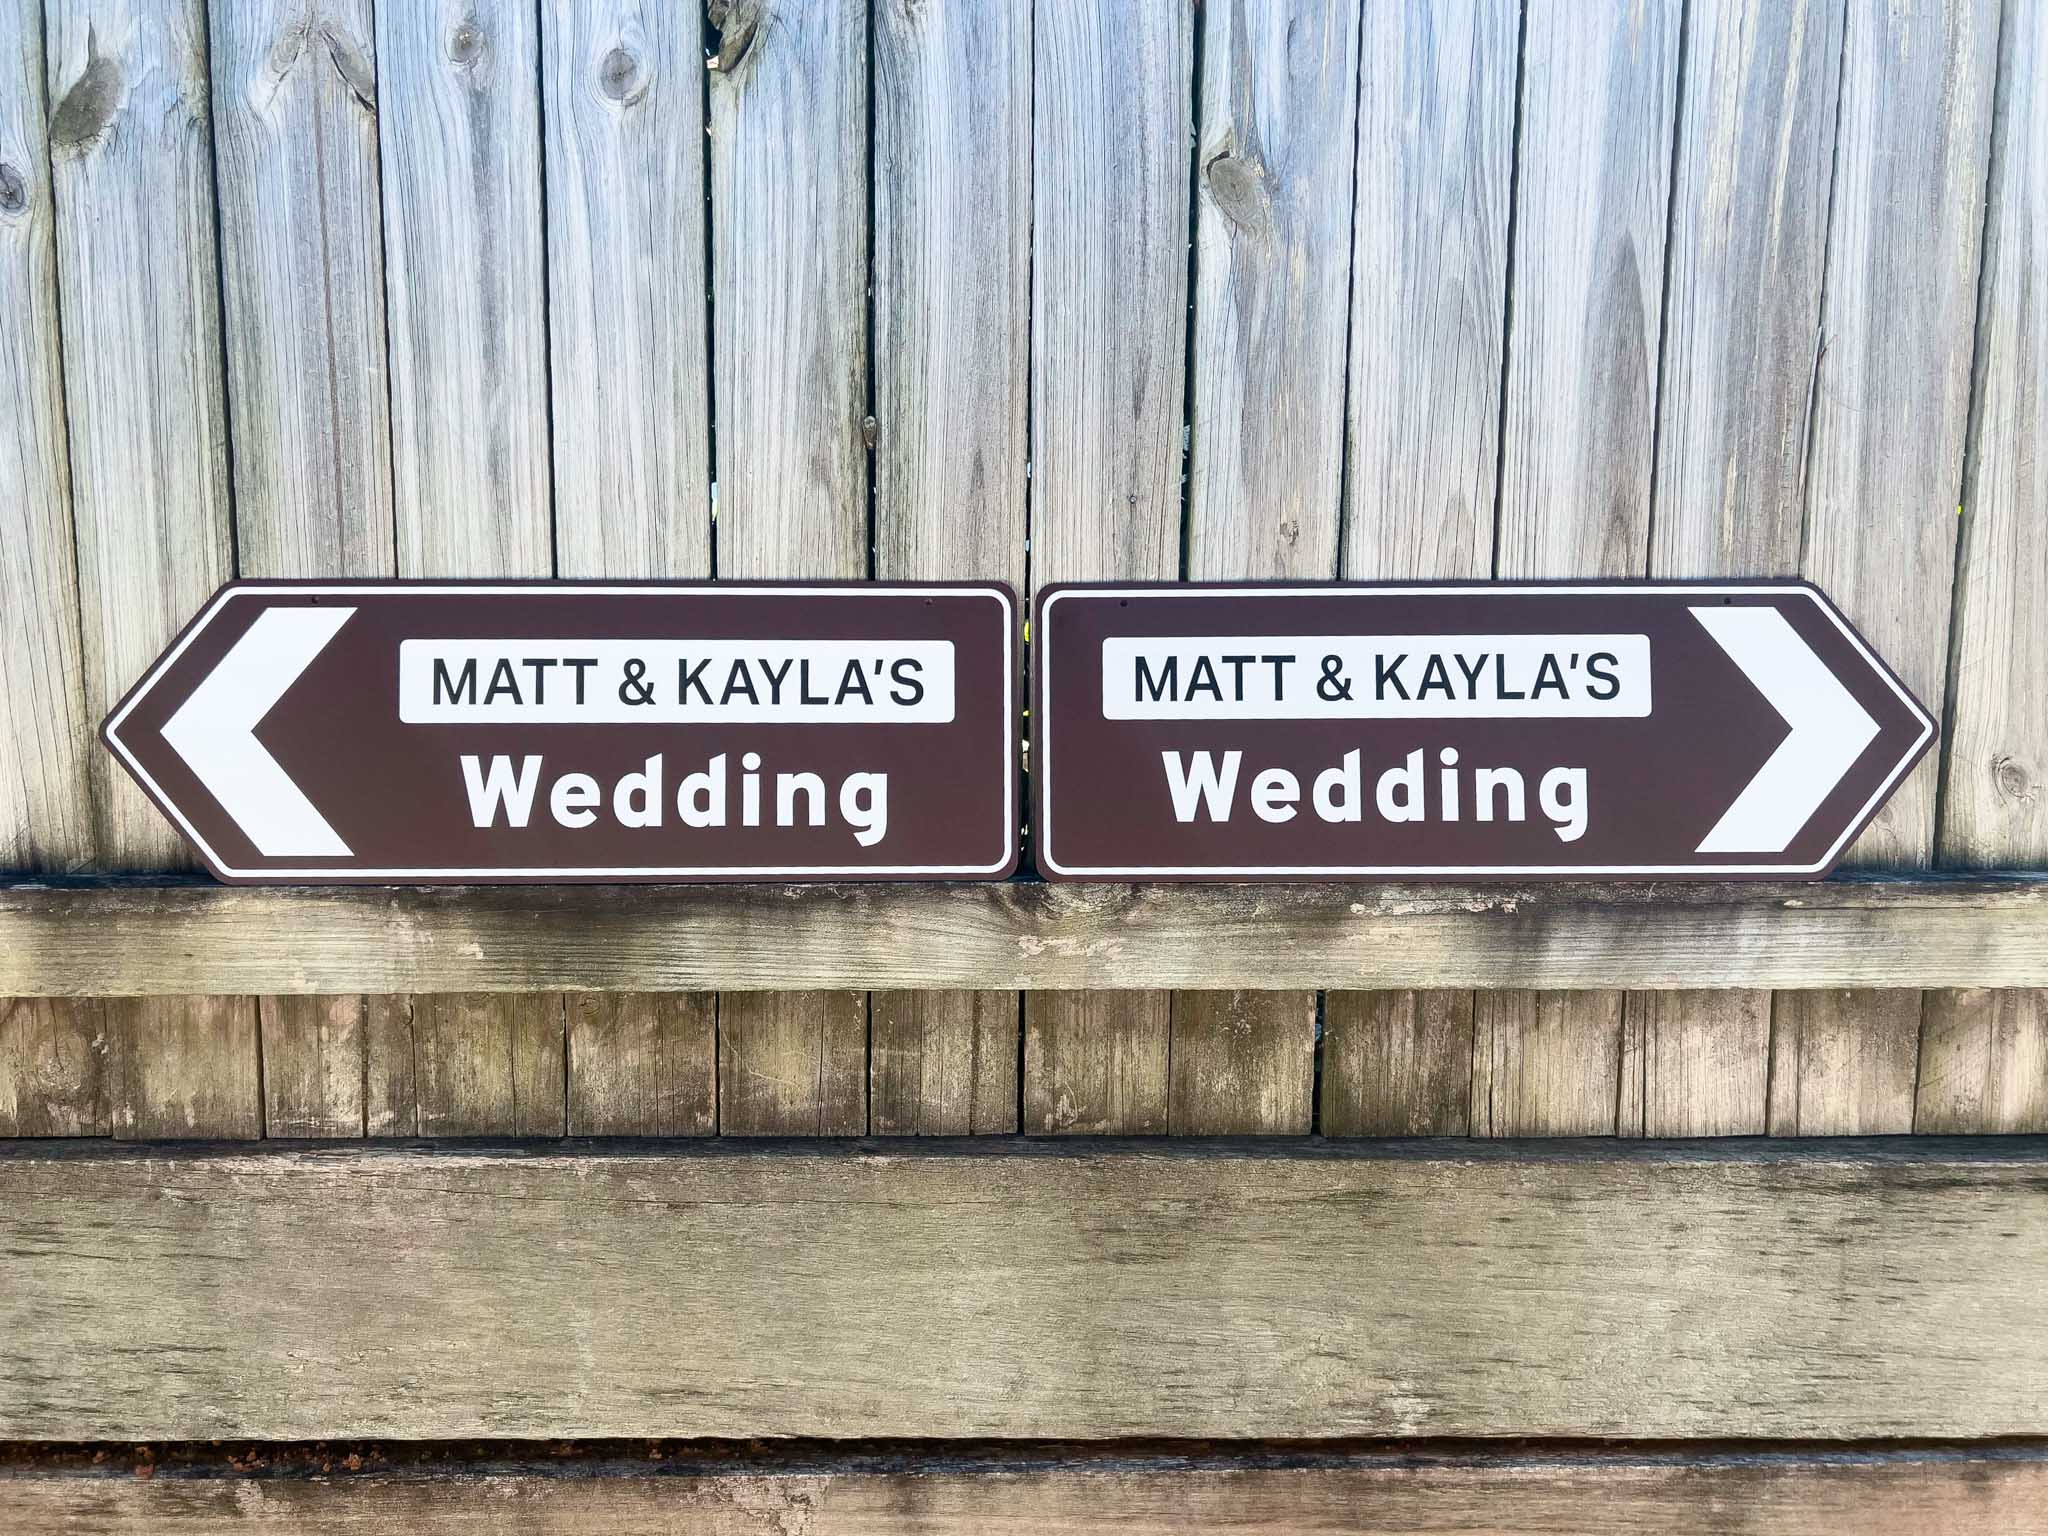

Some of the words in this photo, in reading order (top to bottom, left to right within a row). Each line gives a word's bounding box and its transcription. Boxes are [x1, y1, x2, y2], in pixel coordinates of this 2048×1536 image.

[433, 658, 599, 706] MATT
[618, 658, 657, 706] &
[678, 657, 924, 707] KAYLA'S
[1135, 655, 1296, 702] MATT
[1316, 654, 1354, 702] &
[1375, 652, 1621, 701] KAYLA'S
[459, 752, 888, 847] Wedding
[1161, 746, 1588, 843] Wedding
